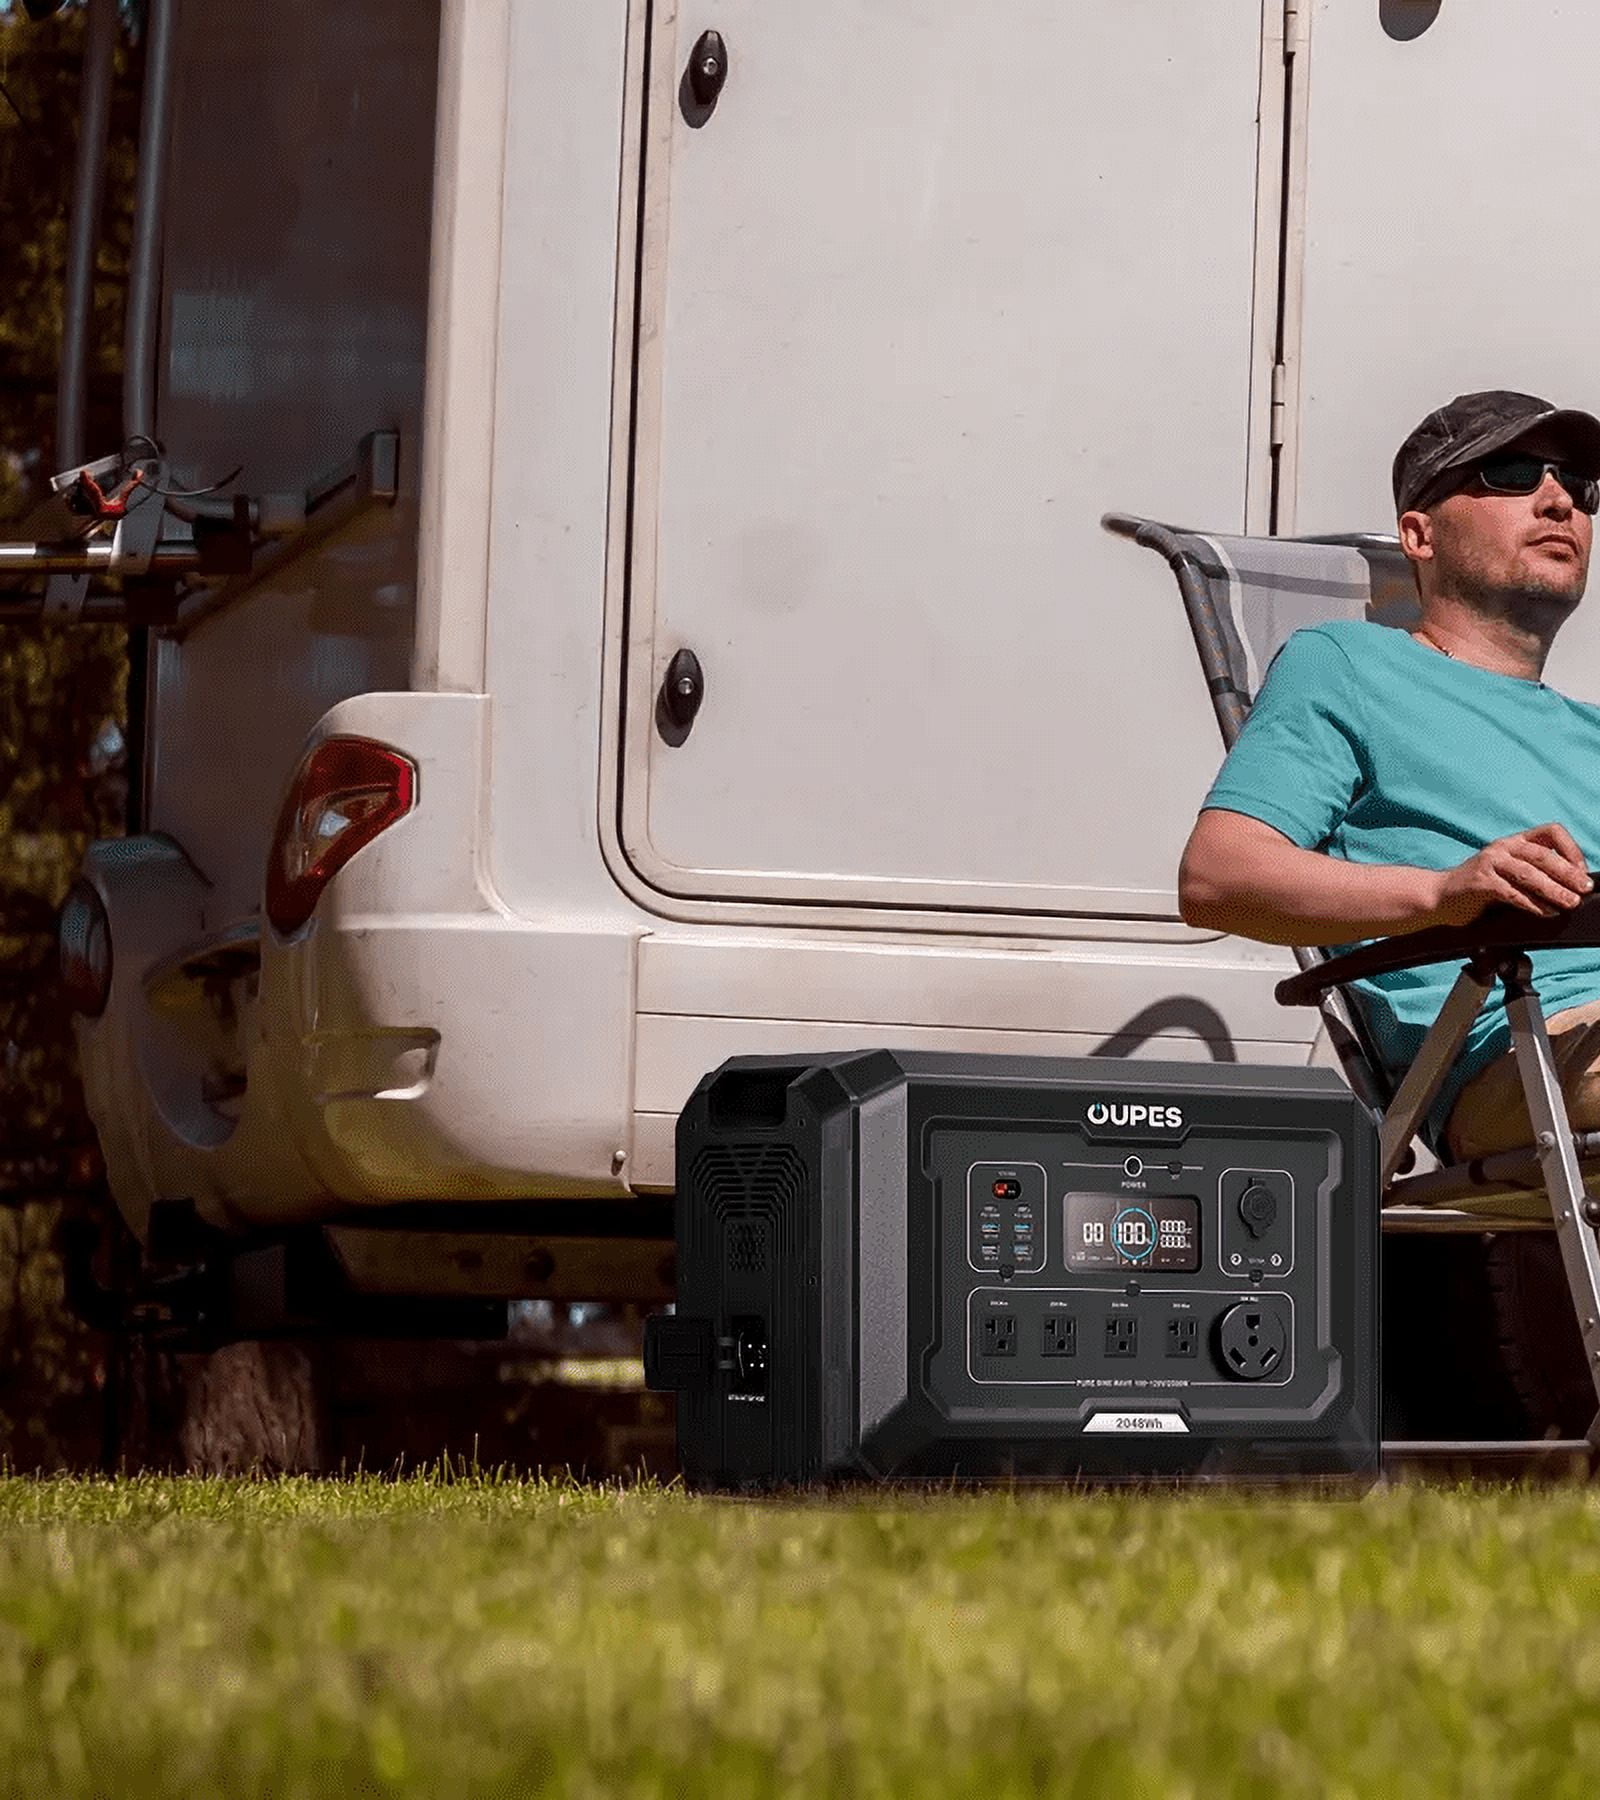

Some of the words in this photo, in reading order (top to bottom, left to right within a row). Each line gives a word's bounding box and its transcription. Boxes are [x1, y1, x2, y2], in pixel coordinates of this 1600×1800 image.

[1087, 1103, 1183, 1128] OUPES
[1121, 1181, 1147, 1189] POWER
[1116, 1417, 1163, 1429] 2048Wh
